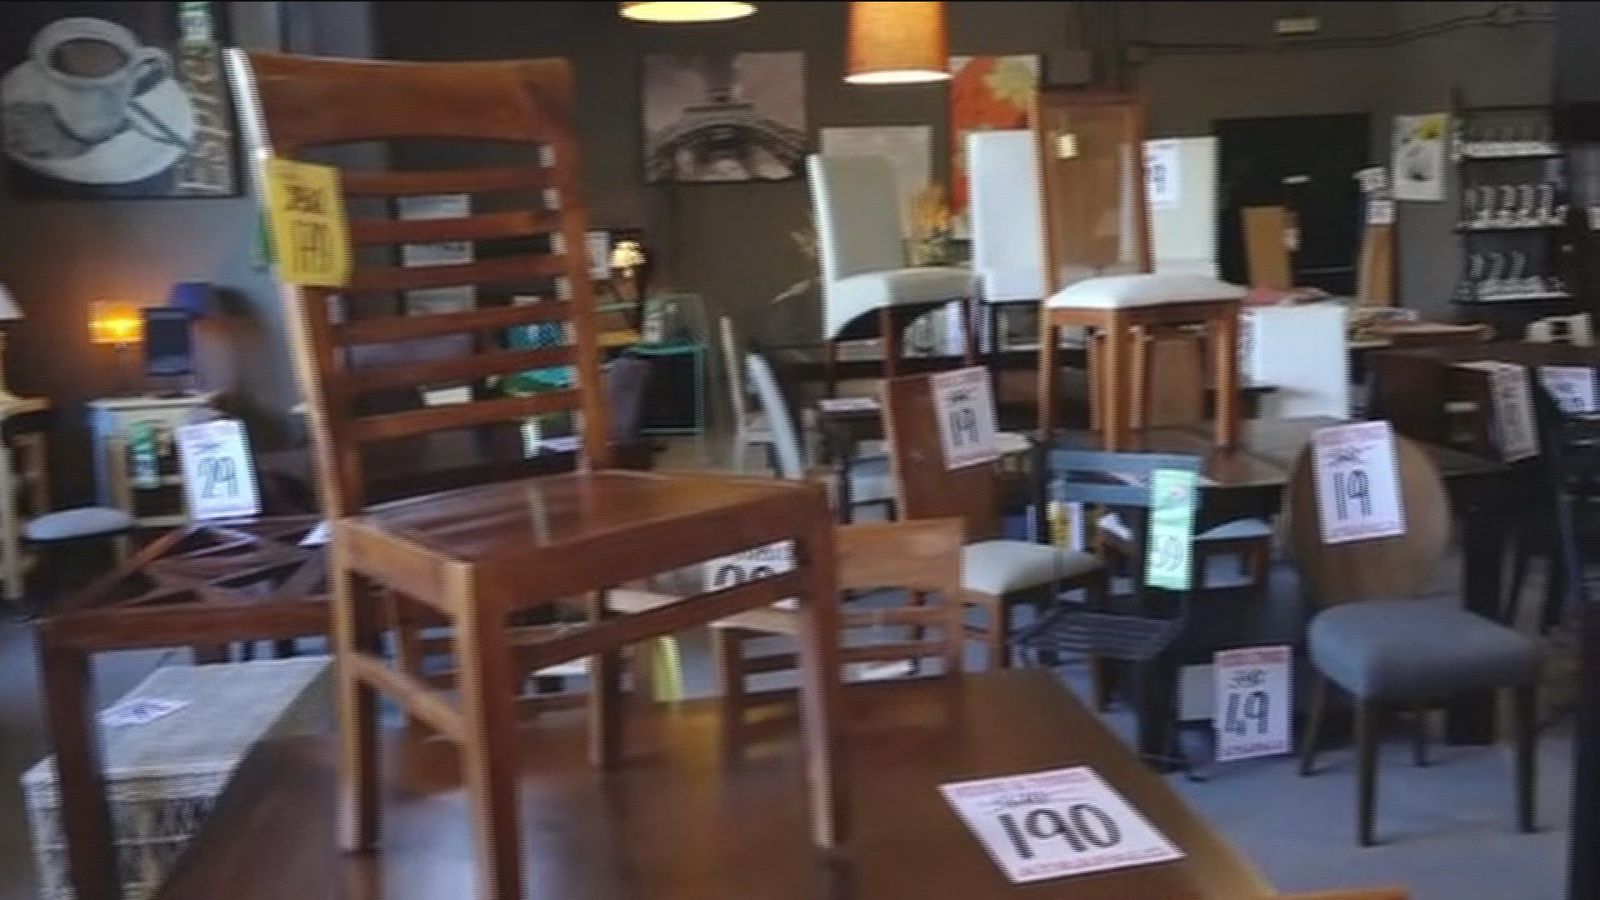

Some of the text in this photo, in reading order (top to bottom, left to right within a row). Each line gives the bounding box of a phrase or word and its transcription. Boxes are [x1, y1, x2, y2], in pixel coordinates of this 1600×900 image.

[1332, 468, 1372, 520] 19
[1224, 689, 1270, 736] 49
[997, 803, 1122, 860] 190
